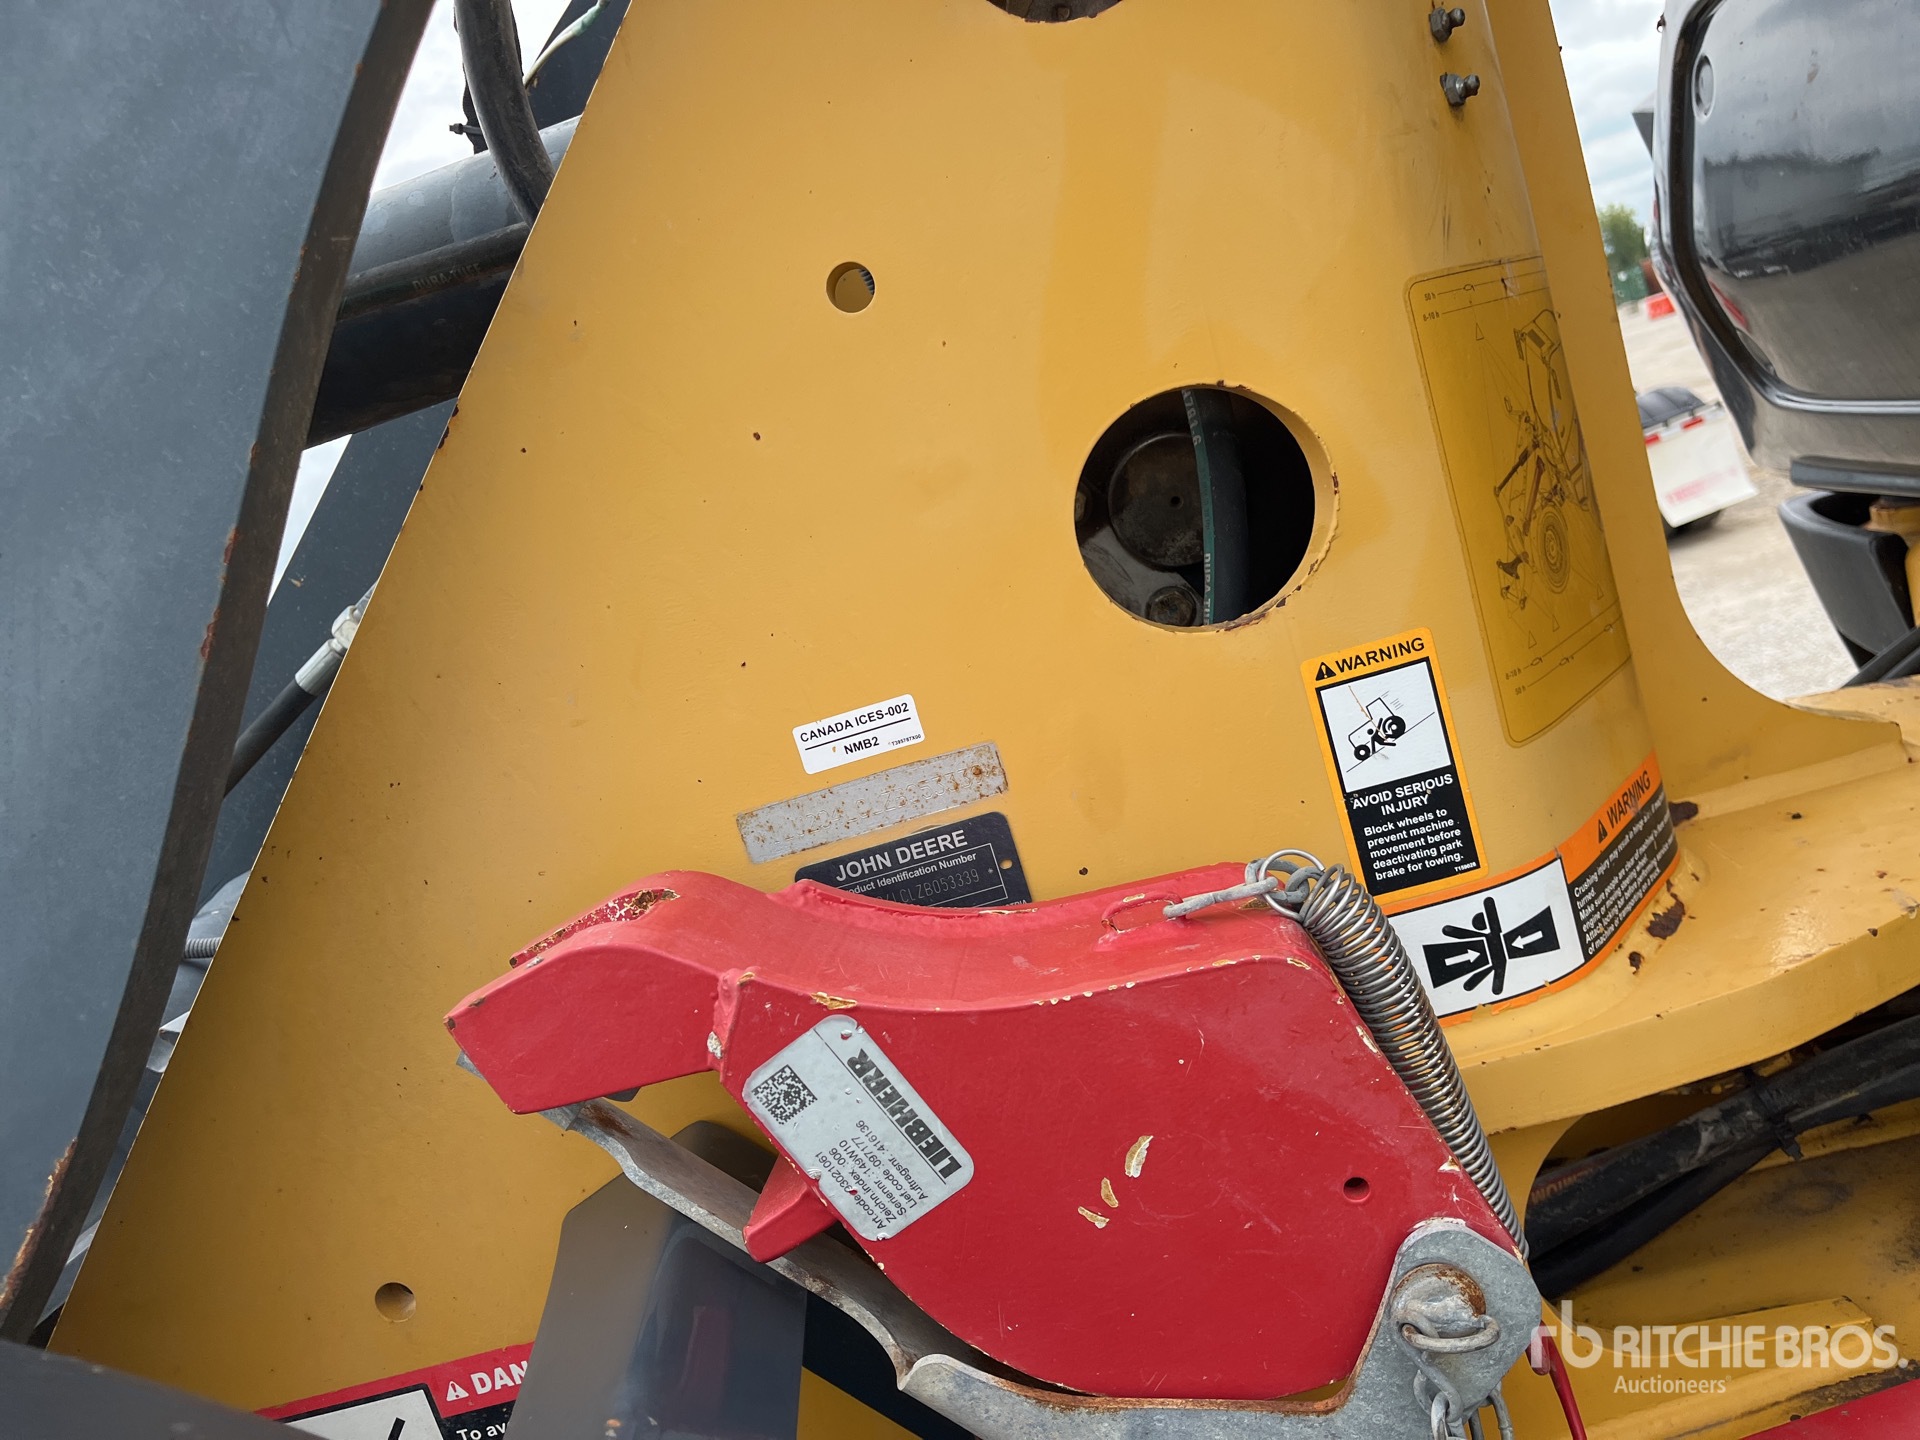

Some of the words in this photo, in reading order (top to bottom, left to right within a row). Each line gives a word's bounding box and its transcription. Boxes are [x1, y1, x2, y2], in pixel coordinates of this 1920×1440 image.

[1336, 637, 1425, 674] WARNING
[800, 720, 854, 743] CANADA
[855, 702, 910, 728] ICES-002
[844, 736, 880, 755] NMB2
[1352, 790, 1393, 810] AVOID
[1395, 774, 1453, 798] SERIOUS
[1380, 795, 1430, 816] INJURY
[1606, 770, 1651, 830] WARNING
[1364, 822, 1395, 837] Block
[1396, 810, 1434, 828] wheels
[1436, 808, 1448, 818] to
[1367, 831, 1408, 849] prevent
[1410, 818, 1454, 840] machine
[836, 852, 892, 883] JOHN
[898, 830, 968, 868] DEERE
[1370, 839, 1426, 858] movement
[1428, 828, 1462, 844] before
[1372, 846, 1438, 870] deactivating
[1440, 839, 1464, 857] park
[849, 879, 876, 896] oduct
[877, 860, 937, 889] Identification
[938, 852, 977, 873] Number
[1375, 867, 1406, 881] brake
[1408, 862, 1422, 874] for
[1424, 853, 1464, 872] towing.
[1574, 872, 1598, 898] Crushing
[1580, 903, 1595, 921] Make
[1594, 892, 1606, 907] sure
[1604, 876, 1619, 898] people
[1582, 912, 1601, 932] engine
[1600, 904, 1606, 915] or
[1606, 887, 1622, 909] moving
[1602, 904, 1619, 926] locking
[846, 1048, 962, 1180] LIEBHERR
[848, 1168, 897, 1223] Zeichn.index
[874, 1176, 906, 1216] Seriennr.
[882, 1168, 918, 1208] Lief.code
[854, 1194, 887, 1229] Art.code
[470, 1360, 528, 1395] DAN
[456, 1428, 482, 1440] To
